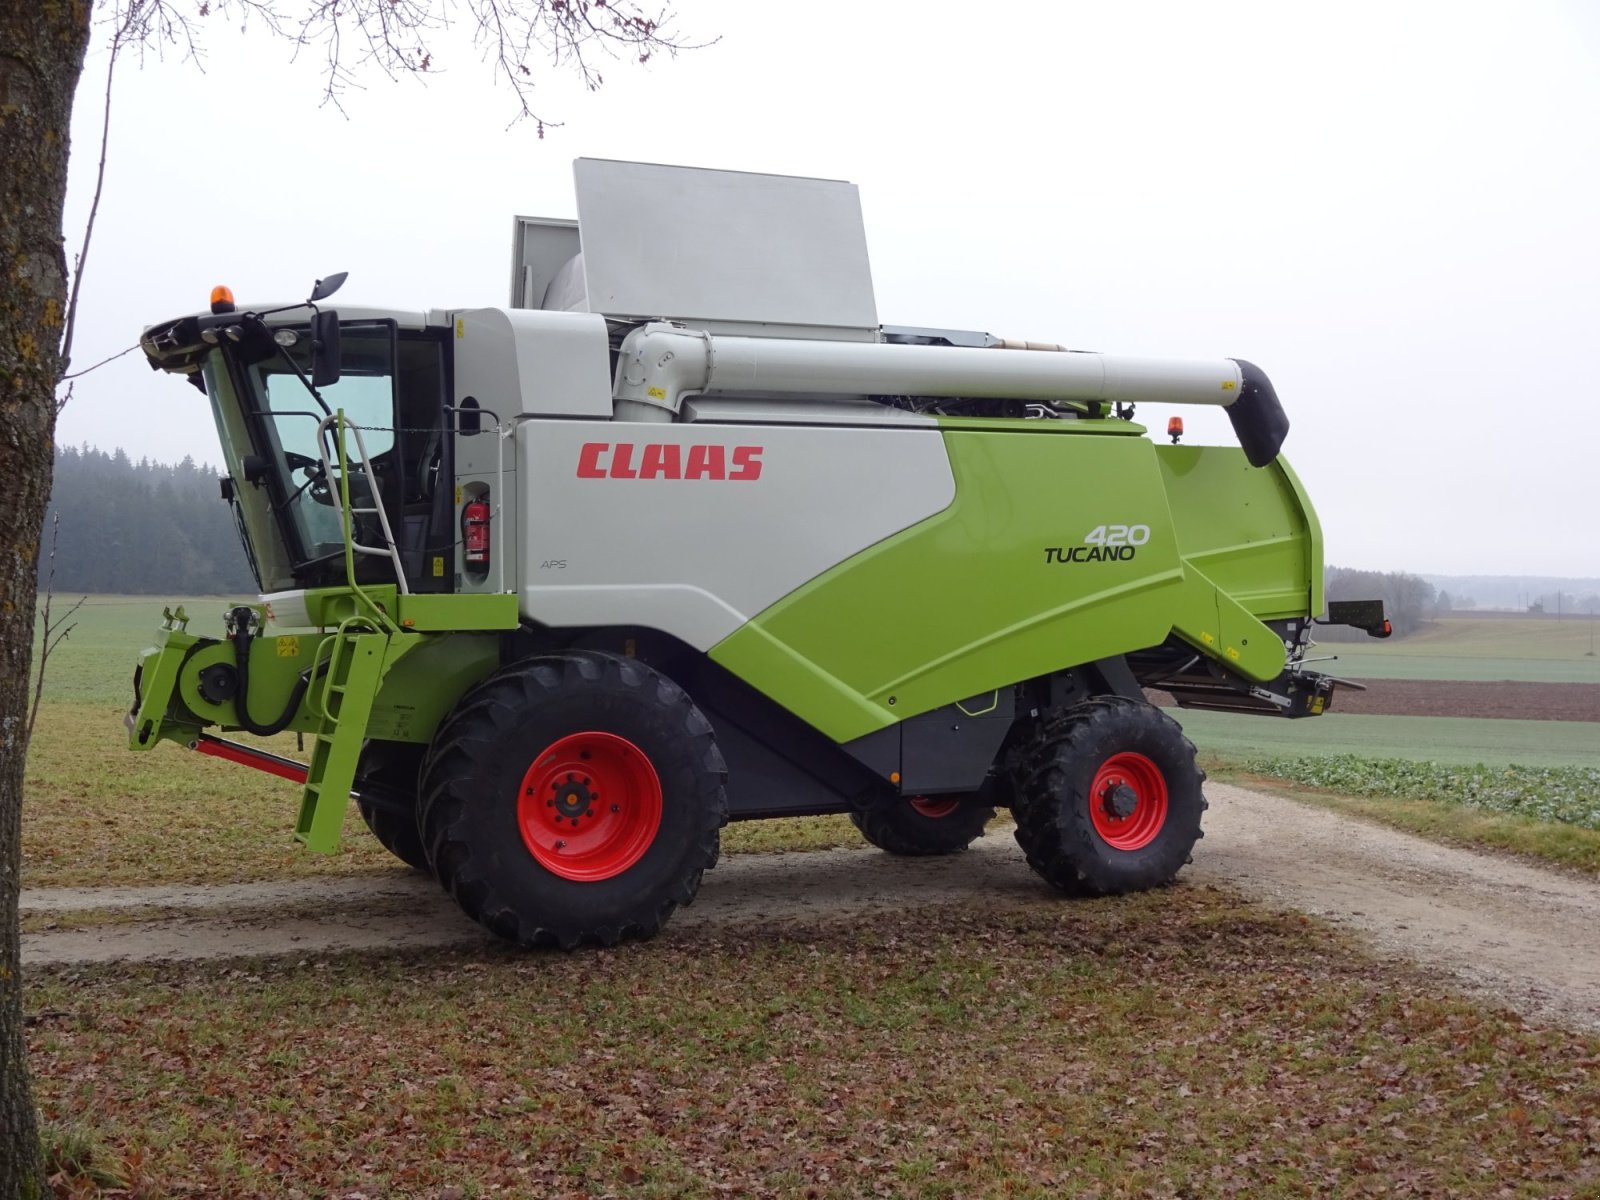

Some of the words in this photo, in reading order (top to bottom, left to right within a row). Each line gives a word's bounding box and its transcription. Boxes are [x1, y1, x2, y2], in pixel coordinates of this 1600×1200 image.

[576, 442, 764, 481] CLAAS
[1084, 525, 1151, 546] 420
[540, 559, 568, 569] APS
[1044, 546, 1136, 564] TUCANO
